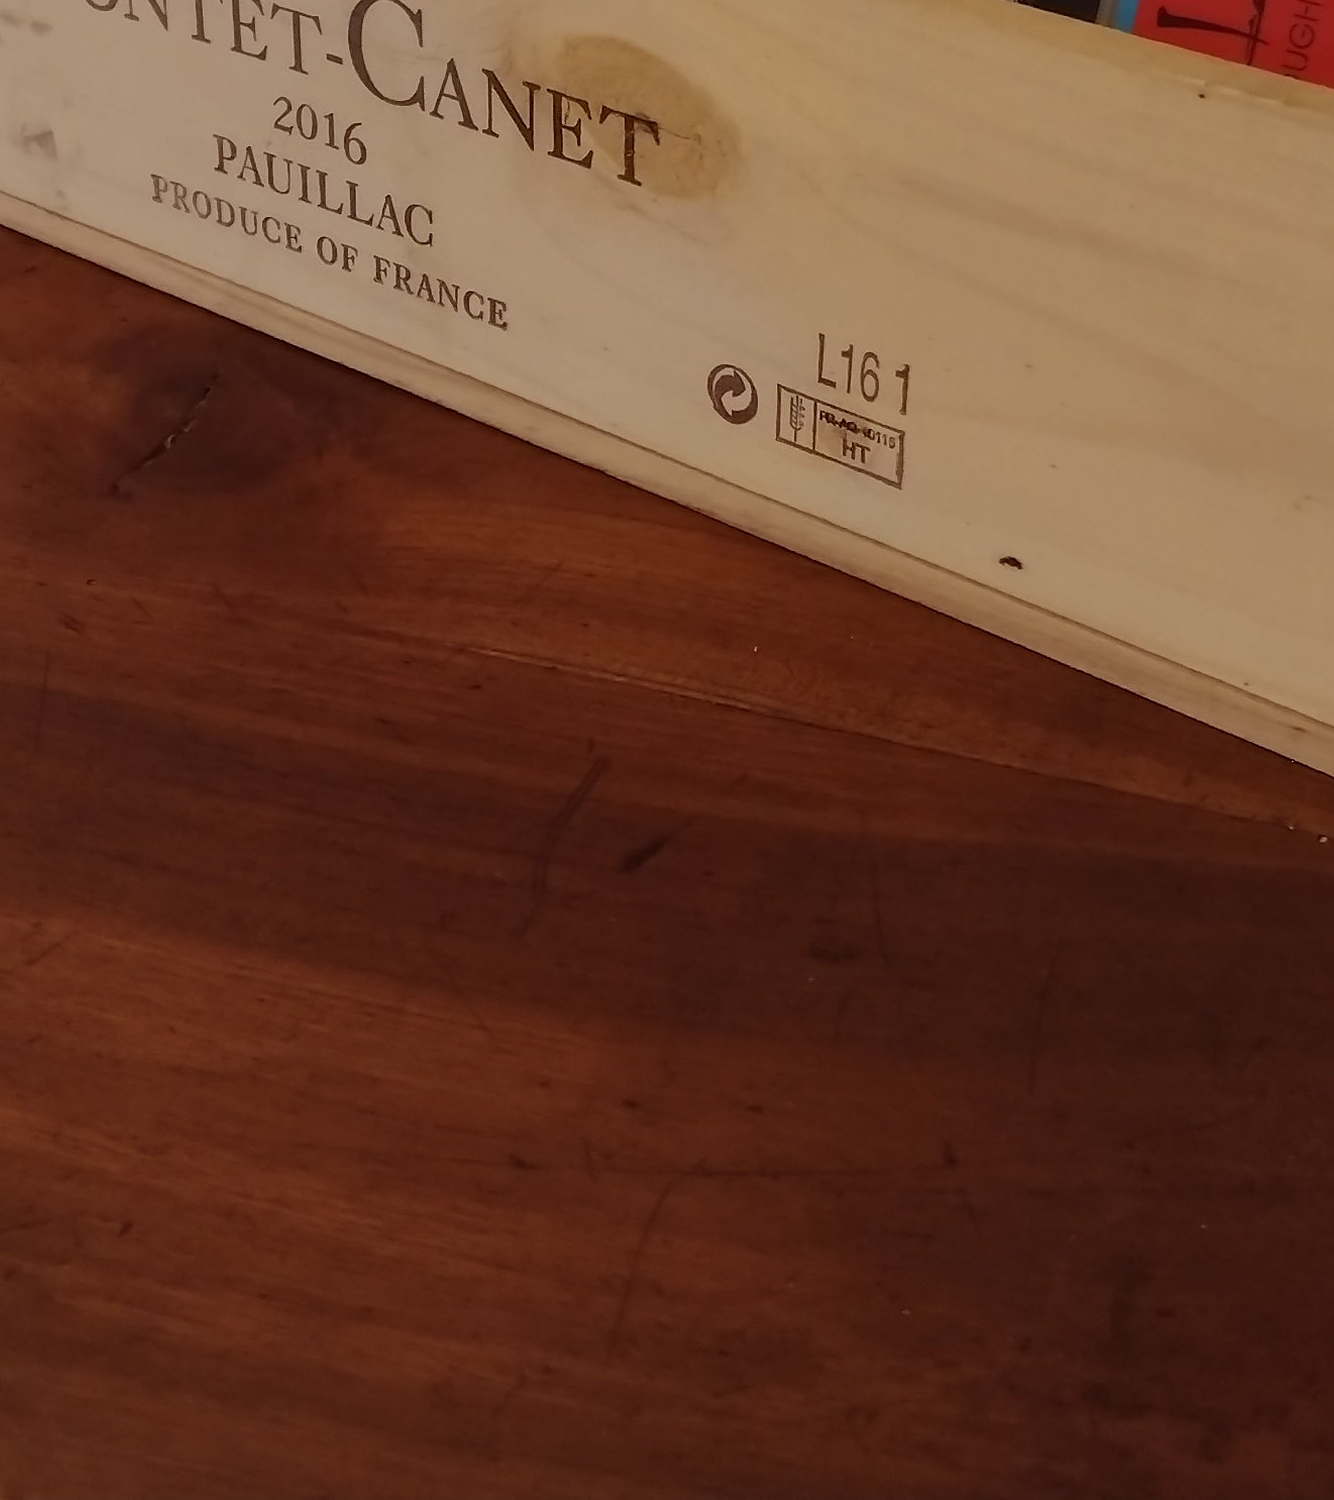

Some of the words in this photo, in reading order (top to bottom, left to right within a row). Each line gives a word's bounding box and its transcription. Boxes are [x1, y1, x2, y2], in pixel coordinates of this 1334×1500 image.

[272, 94, 370, 167] 2016
[211, 133, 436, 248] PAUILLAC
[150, 173, 304, 254] PRODUCE
[316, 233, 358, 274] OF
[374, 252, 509, 332] FRANCE
[841, 431, 871, 464] HT
